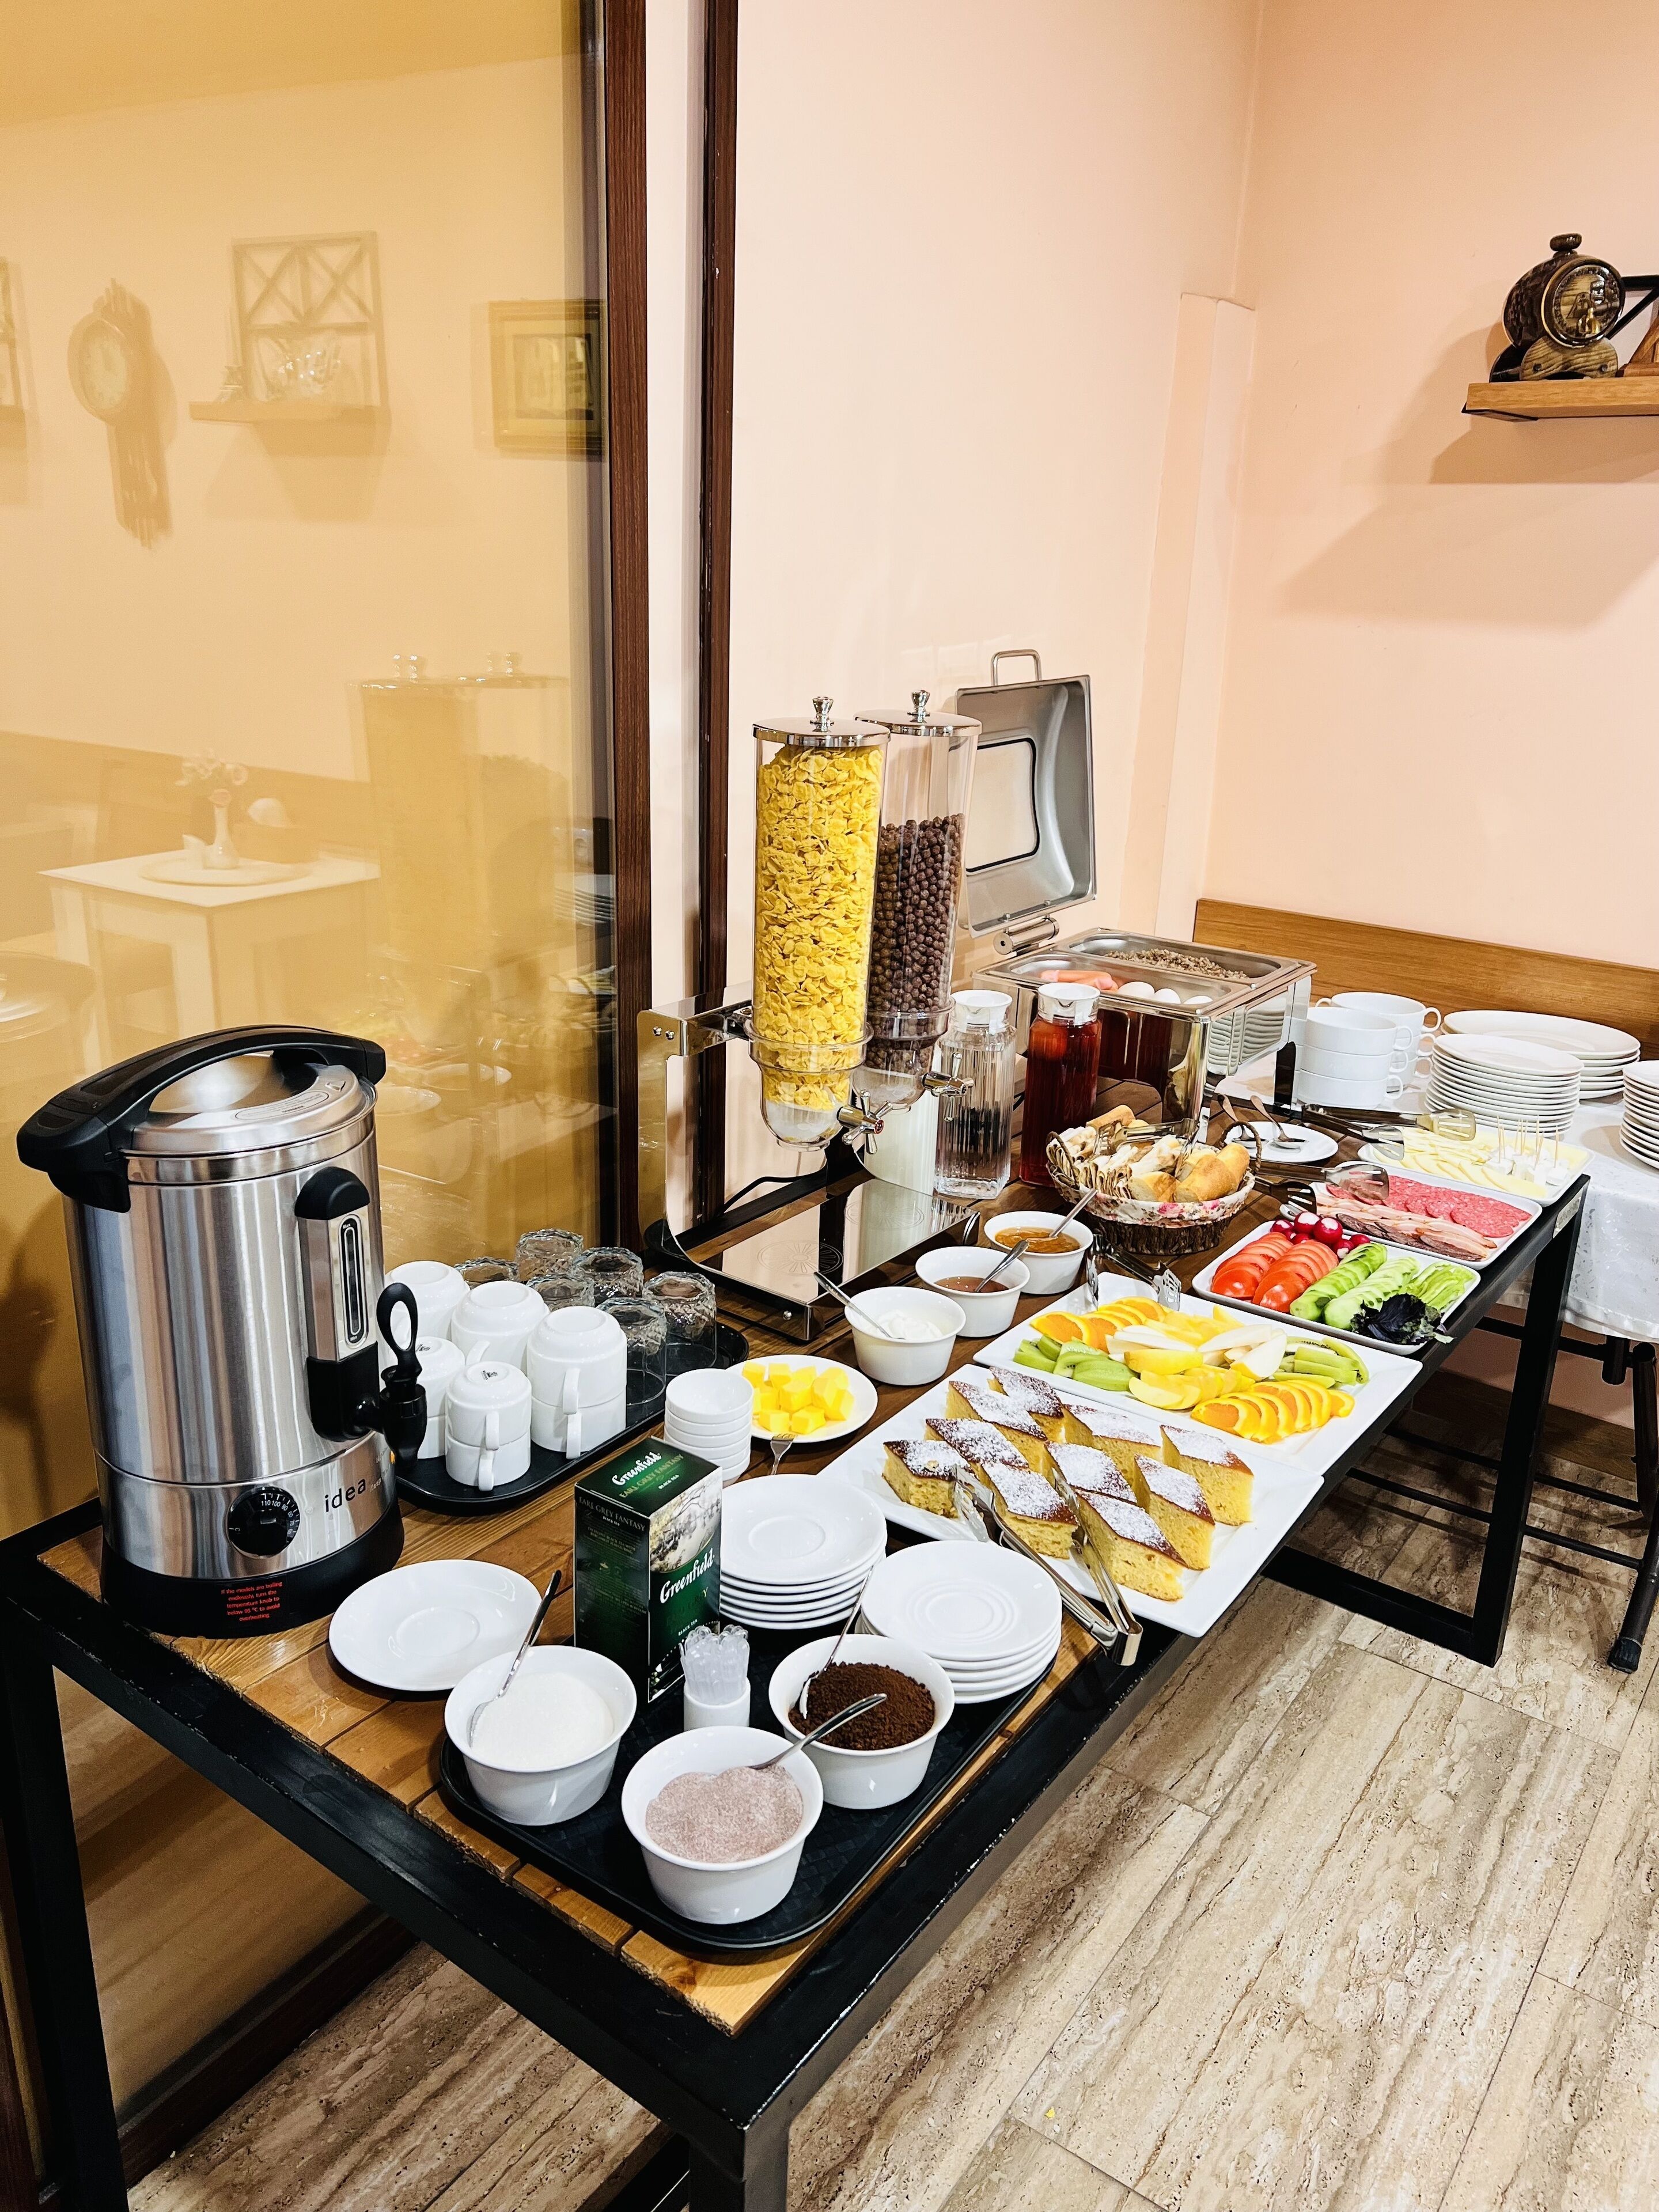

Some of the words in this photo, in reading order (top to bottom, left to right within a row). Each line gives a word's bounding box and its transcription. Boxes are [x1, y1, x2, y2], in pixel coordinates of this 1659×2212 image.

[612, 1452, 662, 1486] Greenfield
[619, 1485, 639, 1498] EARL
[636, 1472, 656, 1486] GREY
[654, 1453, 684, 1474] FANTASY
[271, 1499, 281, 1508] 100
[324, 1479, 366, 1513] idea
[579, 1497, 594, 1510] EARL
[595, 1504, 614, 1518] GREY
[615, 1512, 645, 1532] FANTASY
[660, 1547, 715, 1604] Greenfield
[678, 1624, 691, 1637] BLACK
